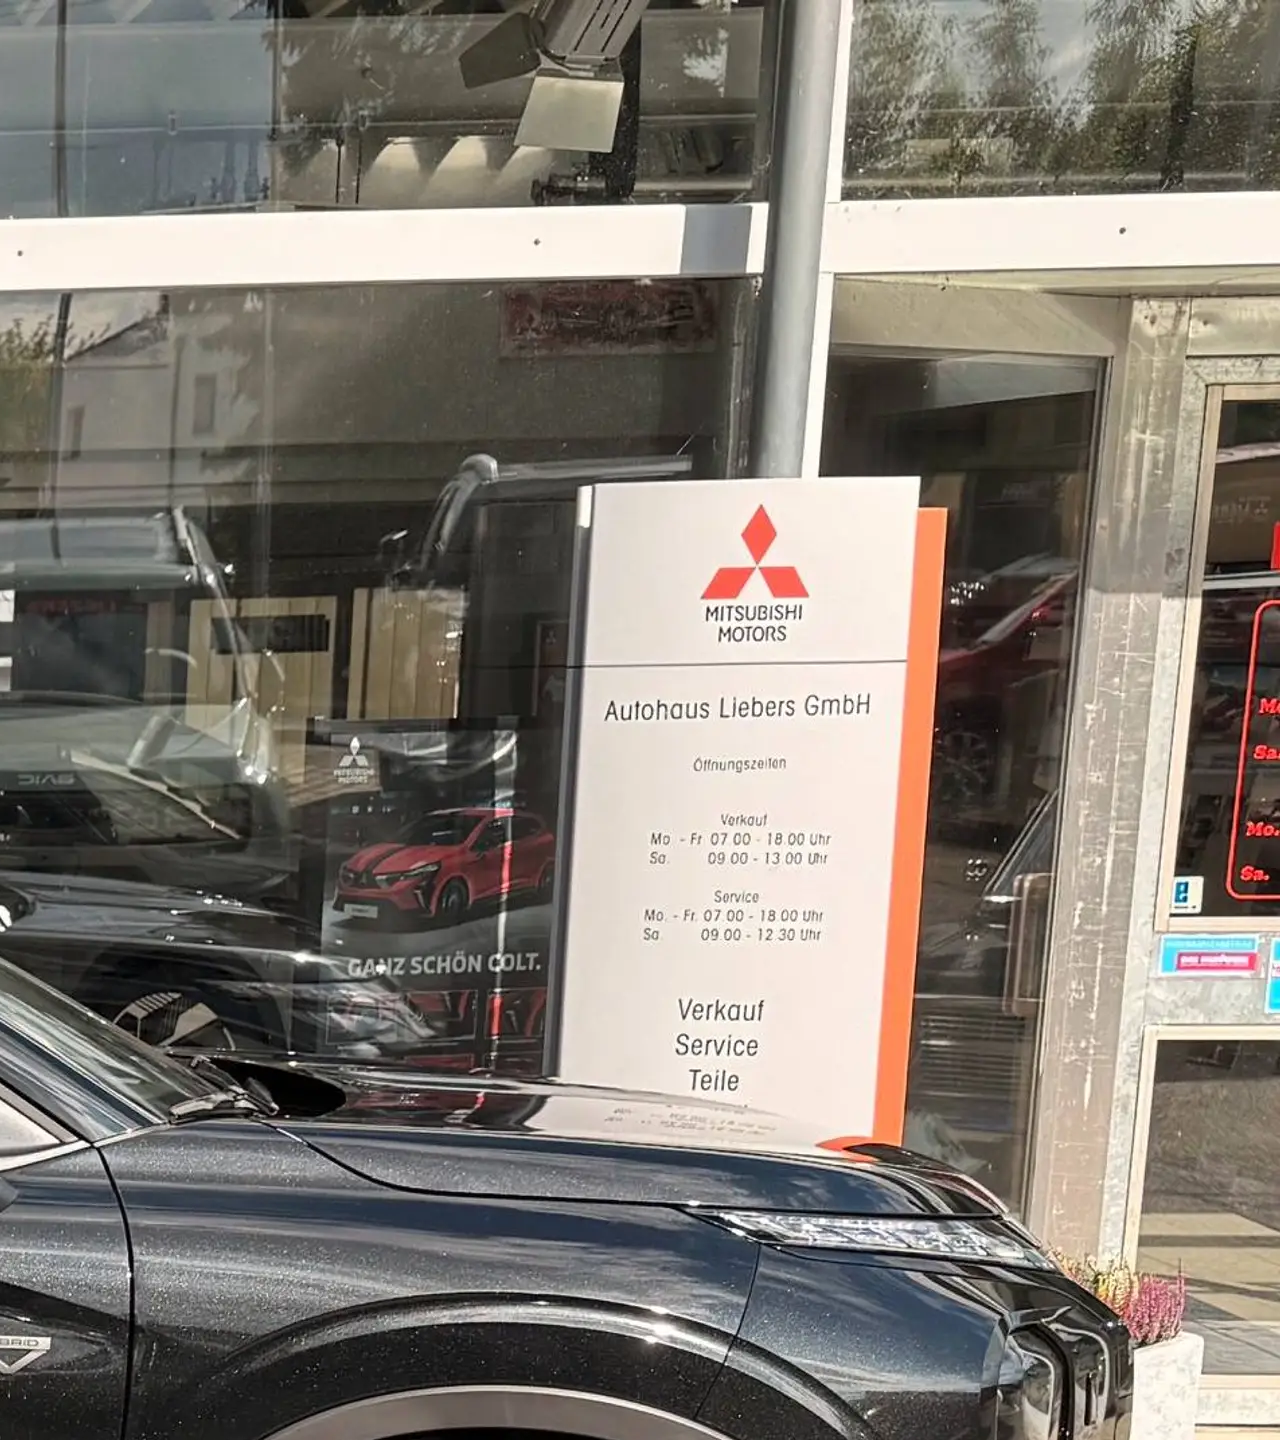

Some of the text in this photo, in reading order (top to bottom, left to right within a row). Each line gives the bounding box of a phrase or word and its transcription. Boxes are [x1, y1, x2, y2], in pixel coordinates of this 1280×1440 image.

[705, 604, 803, 622] MITSUBISHI
[718, 625, 788, 643] MOTORS
[604, 693, 870, 721] Autohaus Liebers GmbH
[693, 756, 787, 773] Öffnungszeiten
[720, 813, 768, 827] Verkauf
[809, 832, 832, 845] Uhr
[808, 852, 828, 865] Uhr
[714, 890, 760, 904] Service
[803, 909, 824, 922] Uhr
[800, 928, 821, 941] Uhr
[347, 951, 541, 978] GANZ SCHÖN COLT.
[678, 998, 764, 1021] Verkauf
[675, 1033, 758, 1056] Service
[689, 1069, 739, 1091] Teile
